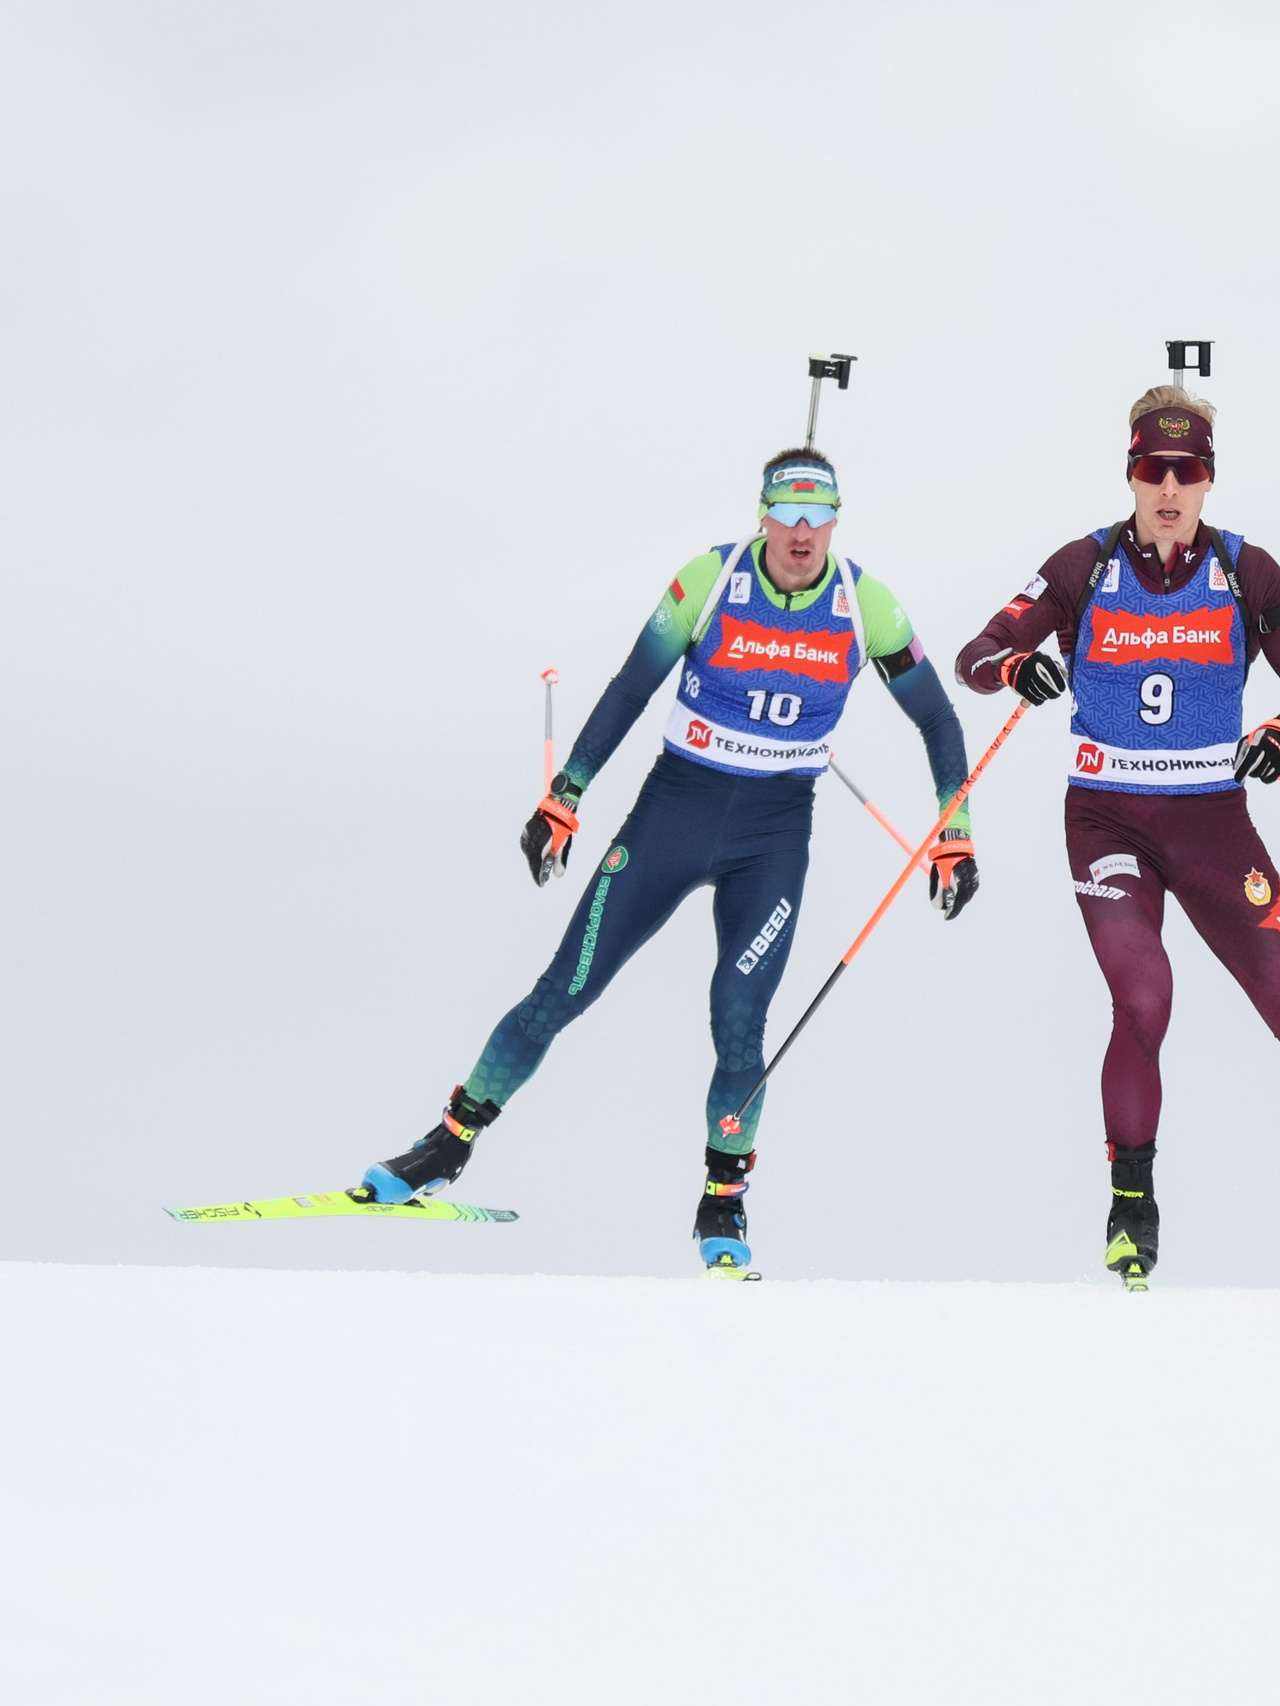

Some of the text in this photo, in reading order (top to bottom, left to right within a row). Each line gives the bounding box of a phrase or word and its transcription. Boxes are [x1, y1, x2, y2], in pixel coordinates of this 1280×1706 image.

[729, 635, 839, 664] Альфа Банк
[1101, 626, 1221, 651] Альфа Банк
[745, 689, 804, 728] 10
[1138, 670, 1176, 727] 9
[1109, 756, 1237, 772] ТЕХНОНИК
[568, 876, 611, 996] БЕЛОРУСНЕФТЬ
[750, 897, 793, 957] BEEU
[1112, 1186, 1145, 1198] CHER
[180, 1206, 240, 1220] FISCHER
